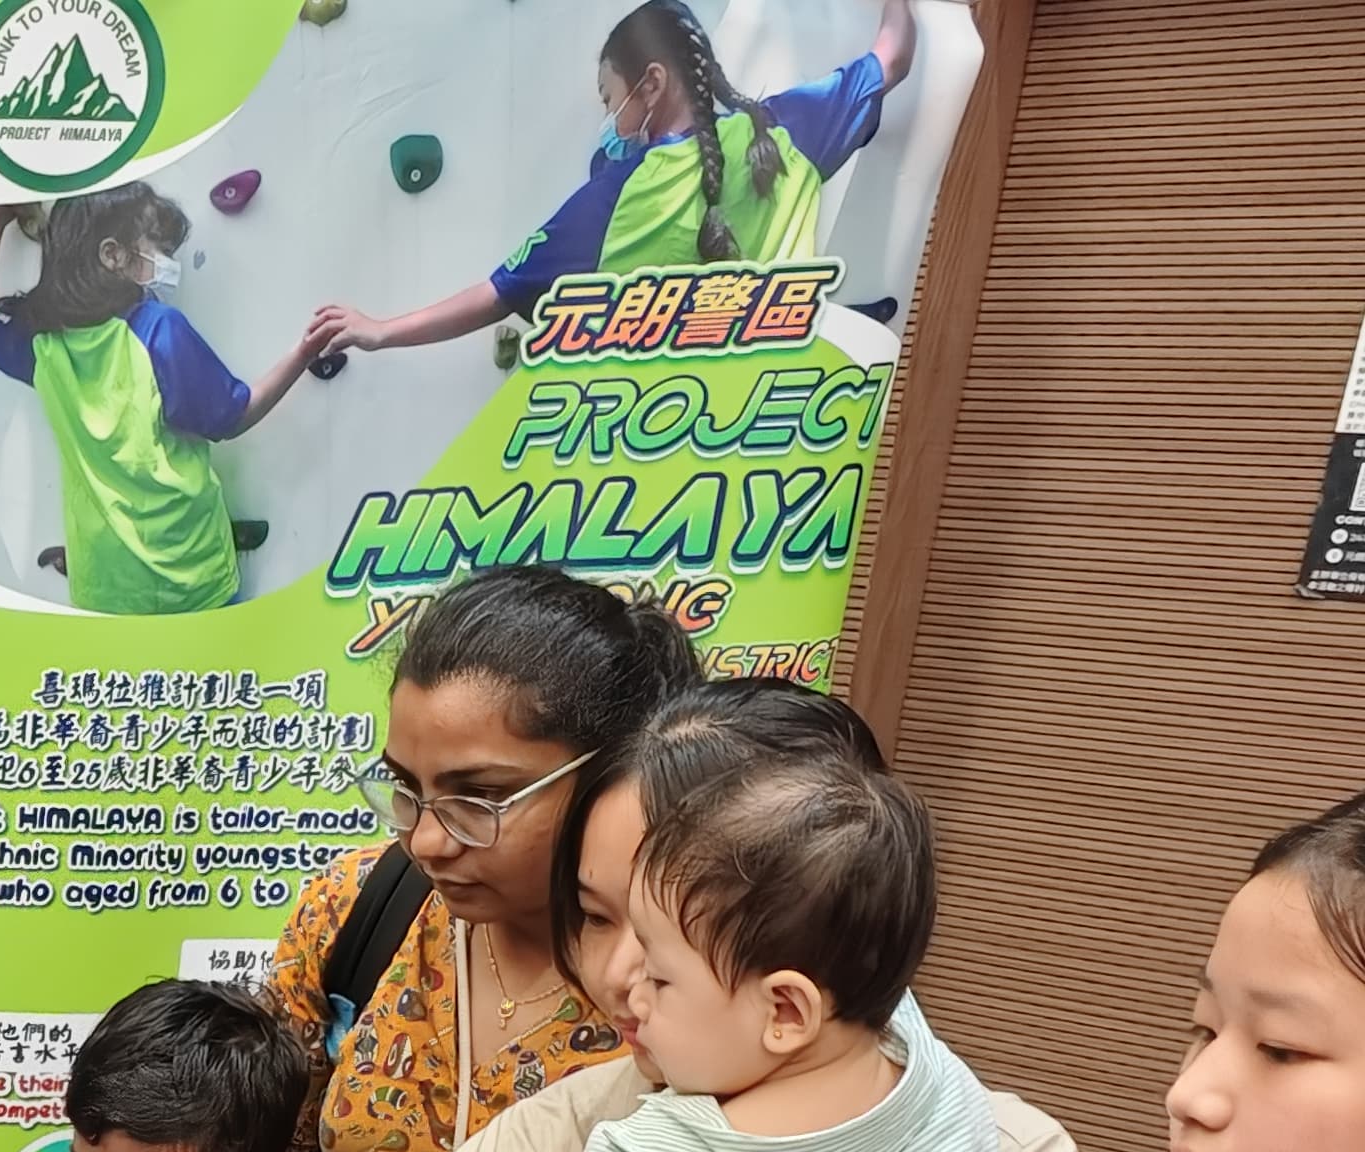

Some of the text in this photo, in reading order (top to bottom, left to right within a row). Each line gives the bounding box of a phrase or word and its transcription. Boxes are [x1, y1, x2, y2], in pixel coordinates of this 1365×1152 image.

[16, 6, 44, 31] TO
[47, 0, 102, 19] YOUR
[102, 10, 142, 79] DREAM
[0, 126, 123, 142] PROJECT HIMALAYA
[527, 264, 839, 354] 元朗警區
[504, 364, 893, 464] PROJECT
[327, 464, 863, 588] HIMALAYA
[35, 671, 324, 707] 喜瑪拉雅計劃是一項
[19, 806, 162, 830] HIMALAYA
[174, 805, 197, 829] is
[211, 805, 375, 831] tailor-made
[71, 844, 183, 872] Minority
[197, 843, 358, 873] youngster
[68, 881, 135, 910] aged
[148, 880, 207, 905] from
[221, 879, 239, 902] 6
[254, 880, 285, 903] to
[19, 1075, 67, 1093] their
